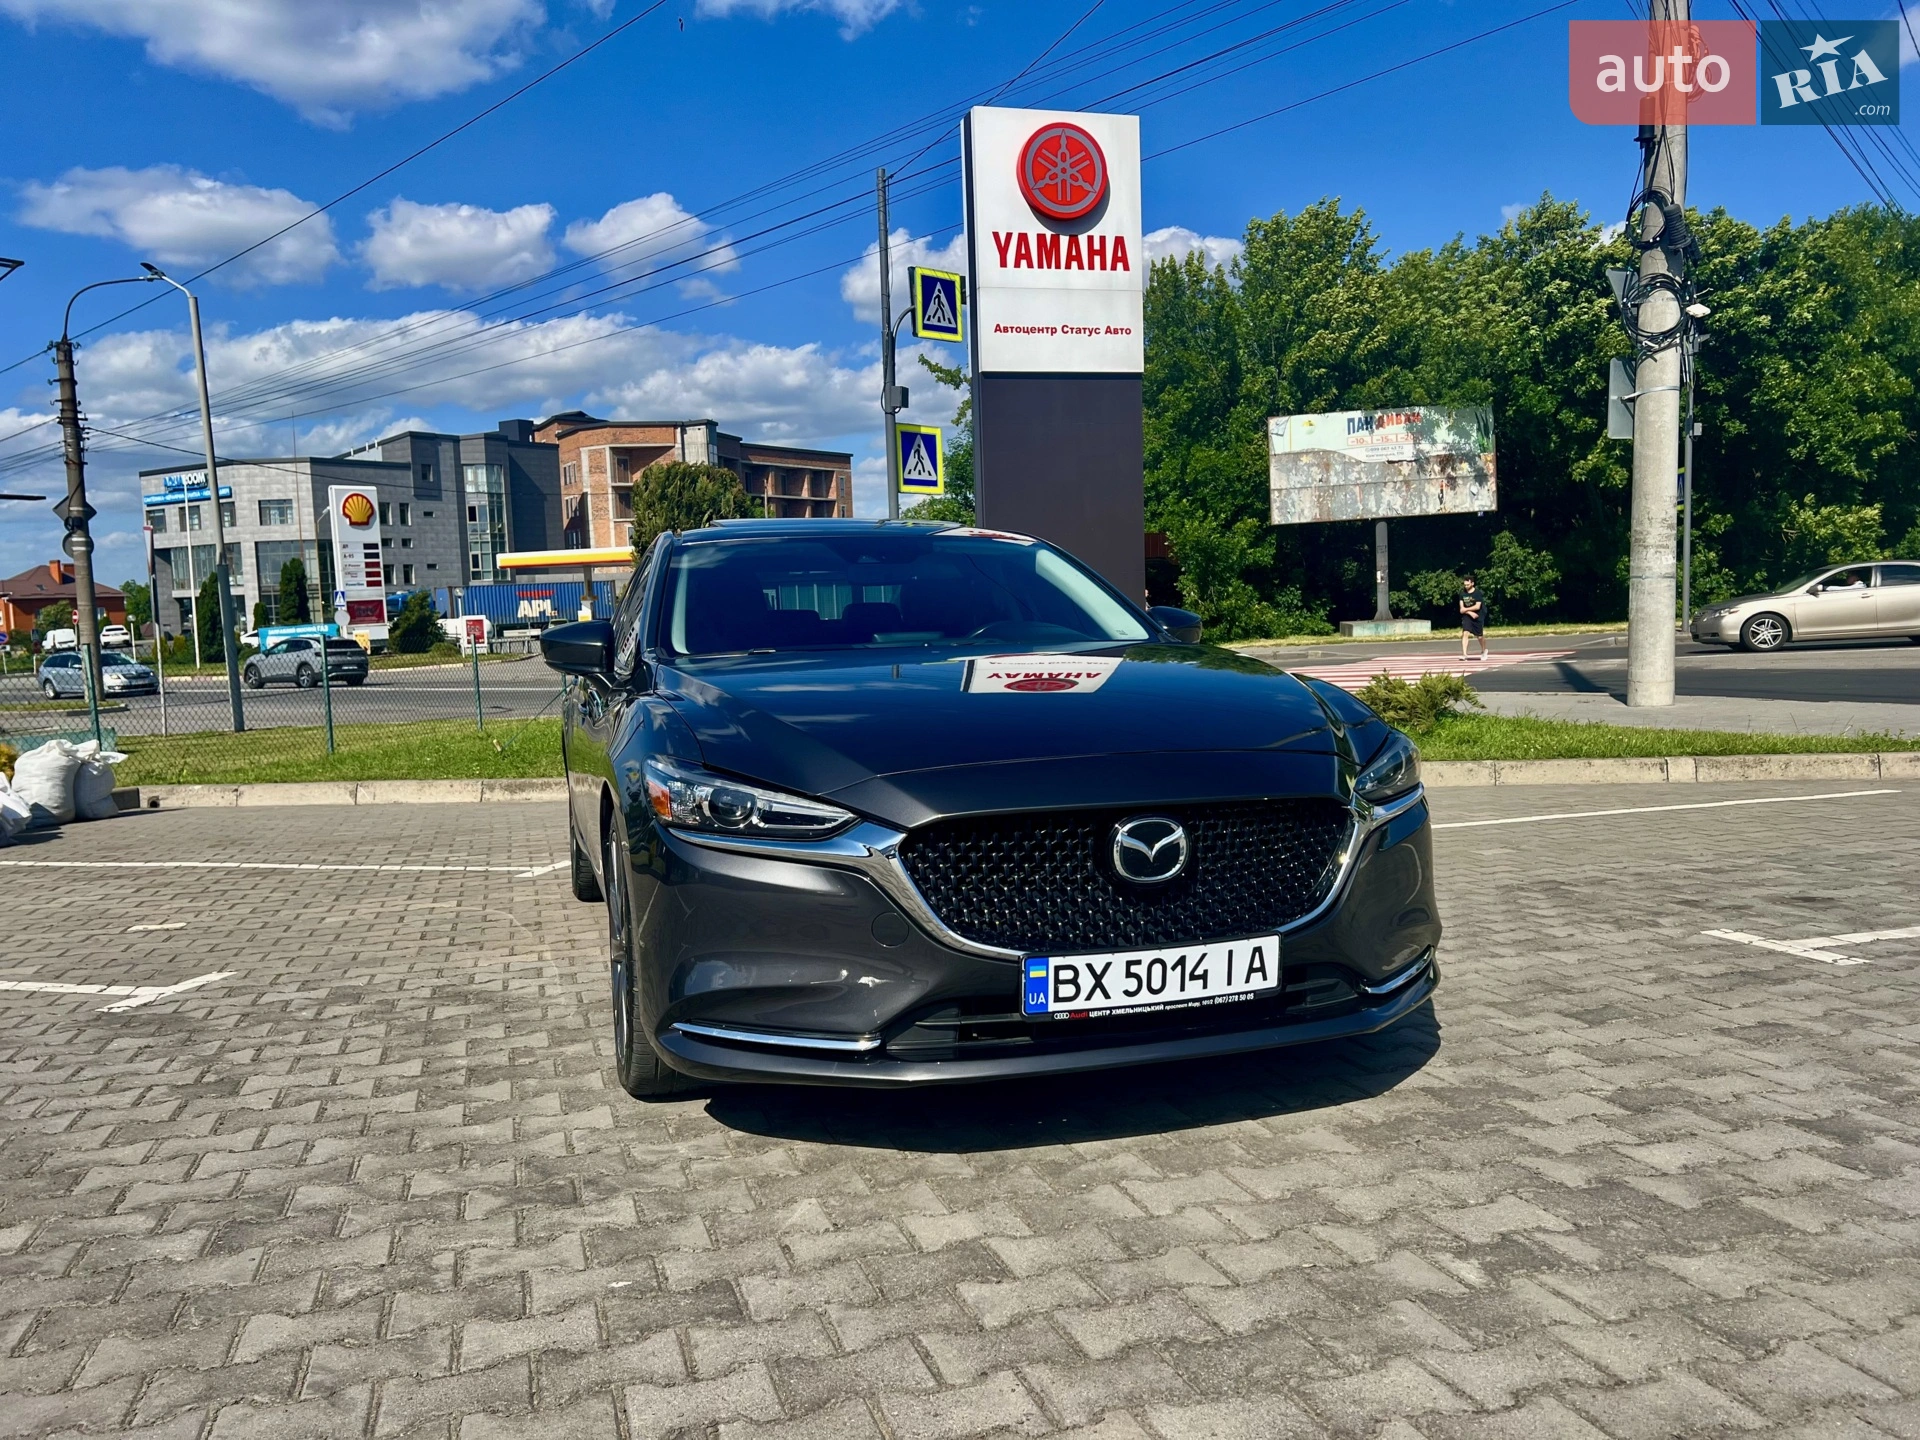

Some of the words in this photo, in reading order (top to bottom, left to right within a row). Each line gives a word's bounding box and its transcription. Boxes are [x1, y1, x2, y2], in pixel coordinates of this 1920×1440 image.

[991, 231, 1130, 272] YAMAHA
[994, 323, 1057, 336] Автоцентр
[1061, 324, 1101, 336] Статус
[1105, 325, 1132, 336] Авто
[1347, 415, 1374, 435] ПАН
[1053, 961, 1113, 1003] BX
[1122, 952, 1209, 997] 5014
[1028, 993, 1046, 1006] UA
[1070, 1011, 1088, 1019] Audi
[1089, 1009, 1111, 1018] ЦЕНТР
[1111, 1003, 1164, 1015] ХМЕЛЬНИЦЬКИЙ
[1214, 995, 1228, 1004] (067)
[1228, 994, 1239, 1002] 278
[1239, 993, 1246, 1001] 50
